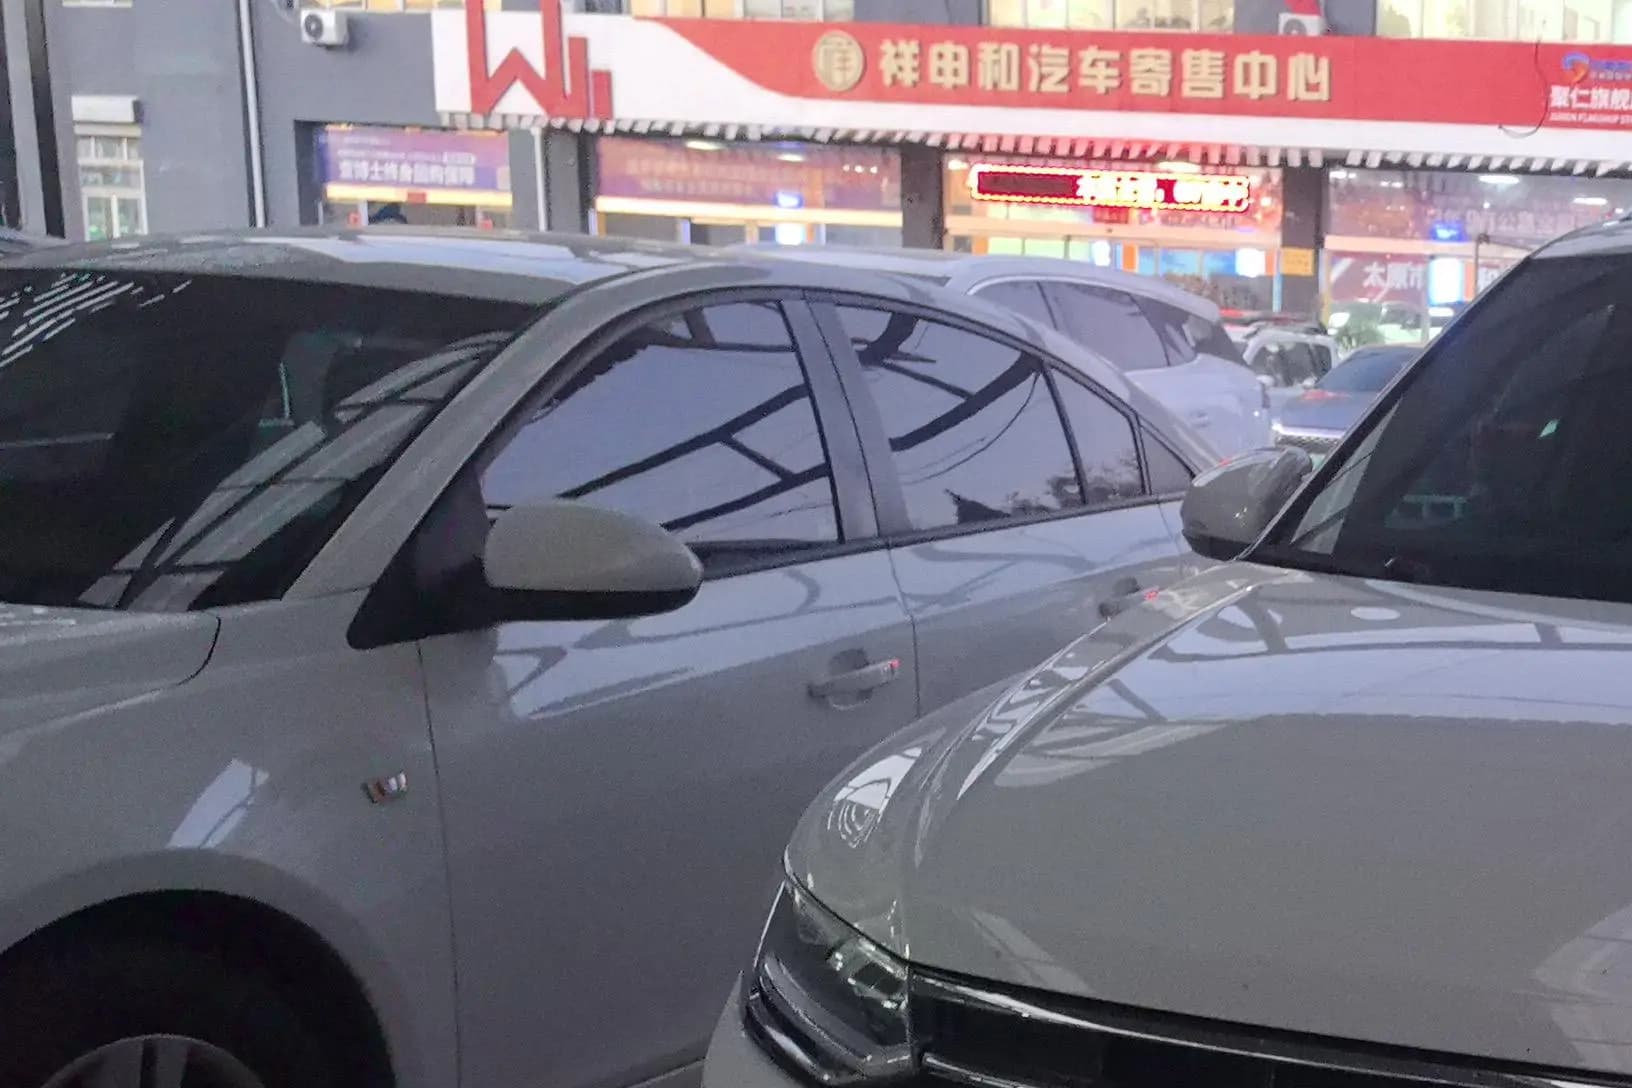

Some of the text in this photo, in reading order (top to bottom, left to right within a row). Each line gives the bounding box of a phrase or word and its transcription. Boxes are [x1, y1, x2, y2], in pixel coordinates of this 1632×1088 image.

[879, 38, 1331, 101] 祥申和汽车寄售中心
